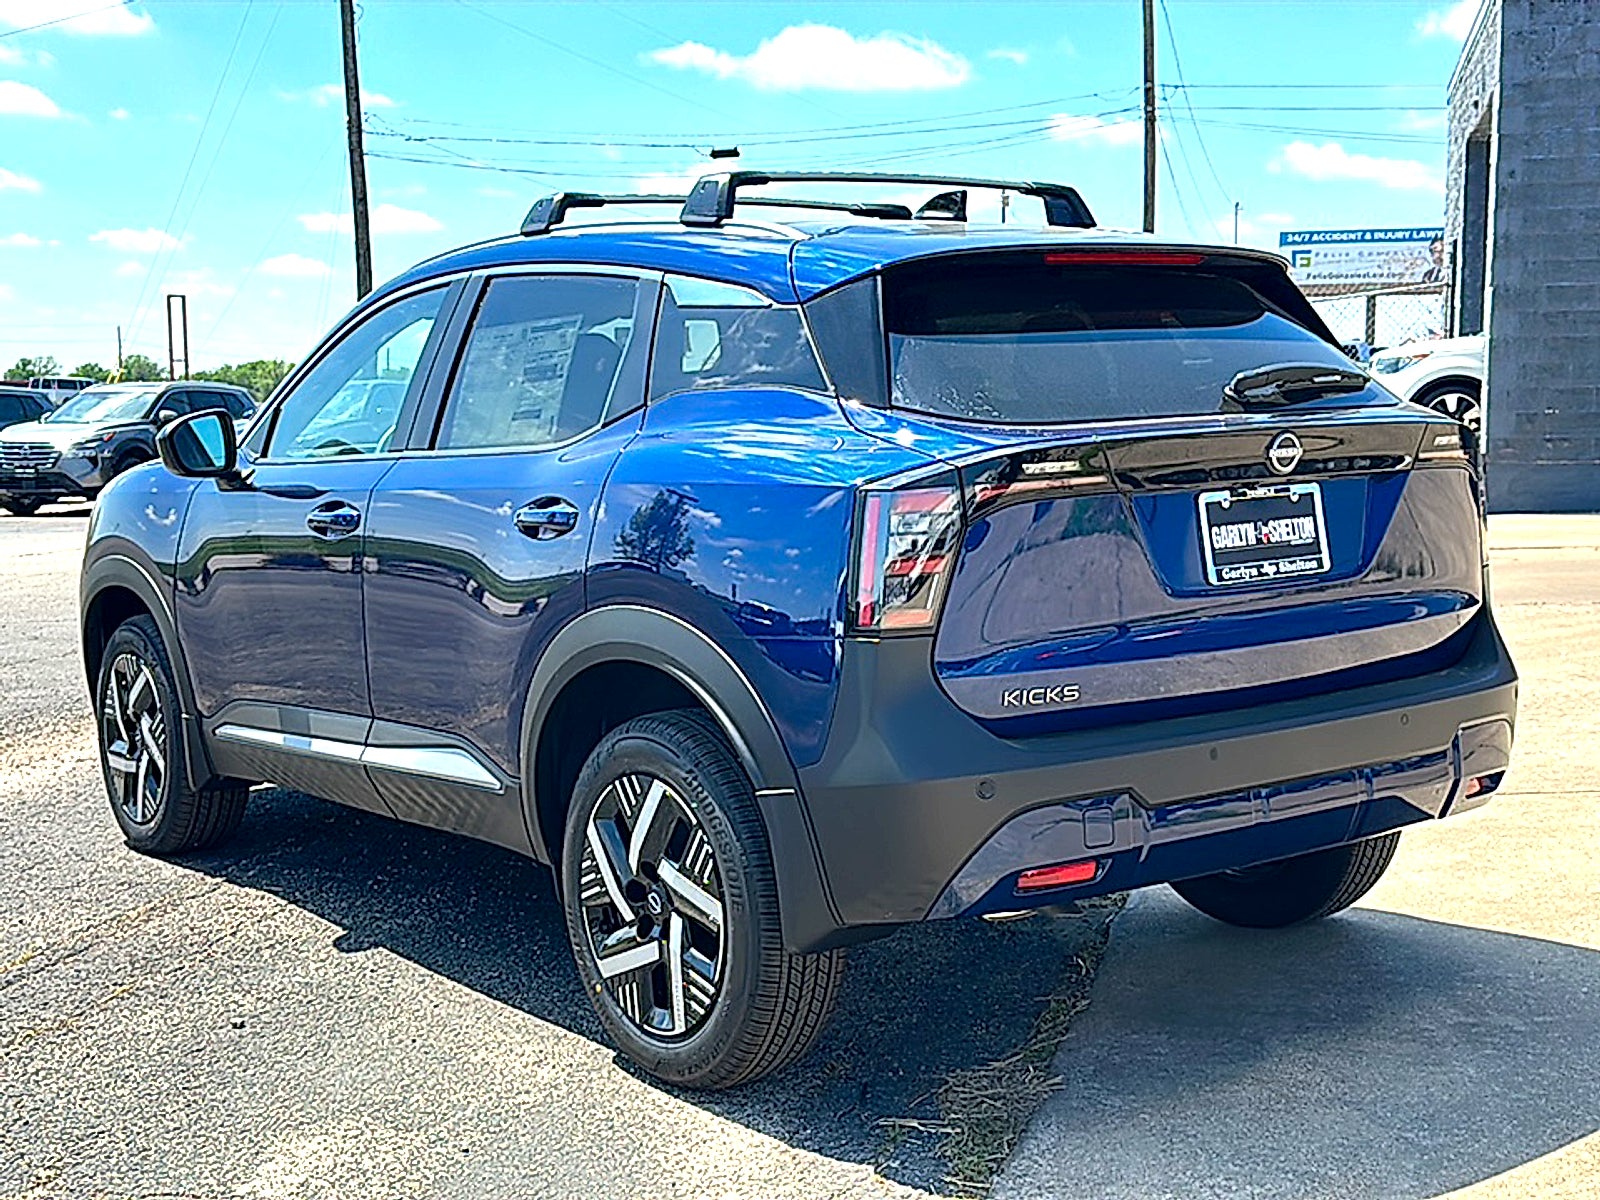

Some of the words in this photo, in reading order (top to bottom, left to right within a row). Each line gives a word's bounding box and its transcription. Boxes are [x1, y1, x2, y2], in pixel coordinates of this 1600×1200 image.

[1287, 233, 1310, 242] 24/7
[1312, 231, 1363, 241] ACCIDENT
[1364, 231, 1372, 240] &
[1374, 230, 1411, 240] INJURY
[1211, 522, 1256, 549] GARLYN
[1268, 516, 1315, 542] SHELTON
[1279, 560, 1318, 573] Shelton
[1003, 684, 1080, 706] KICKS
